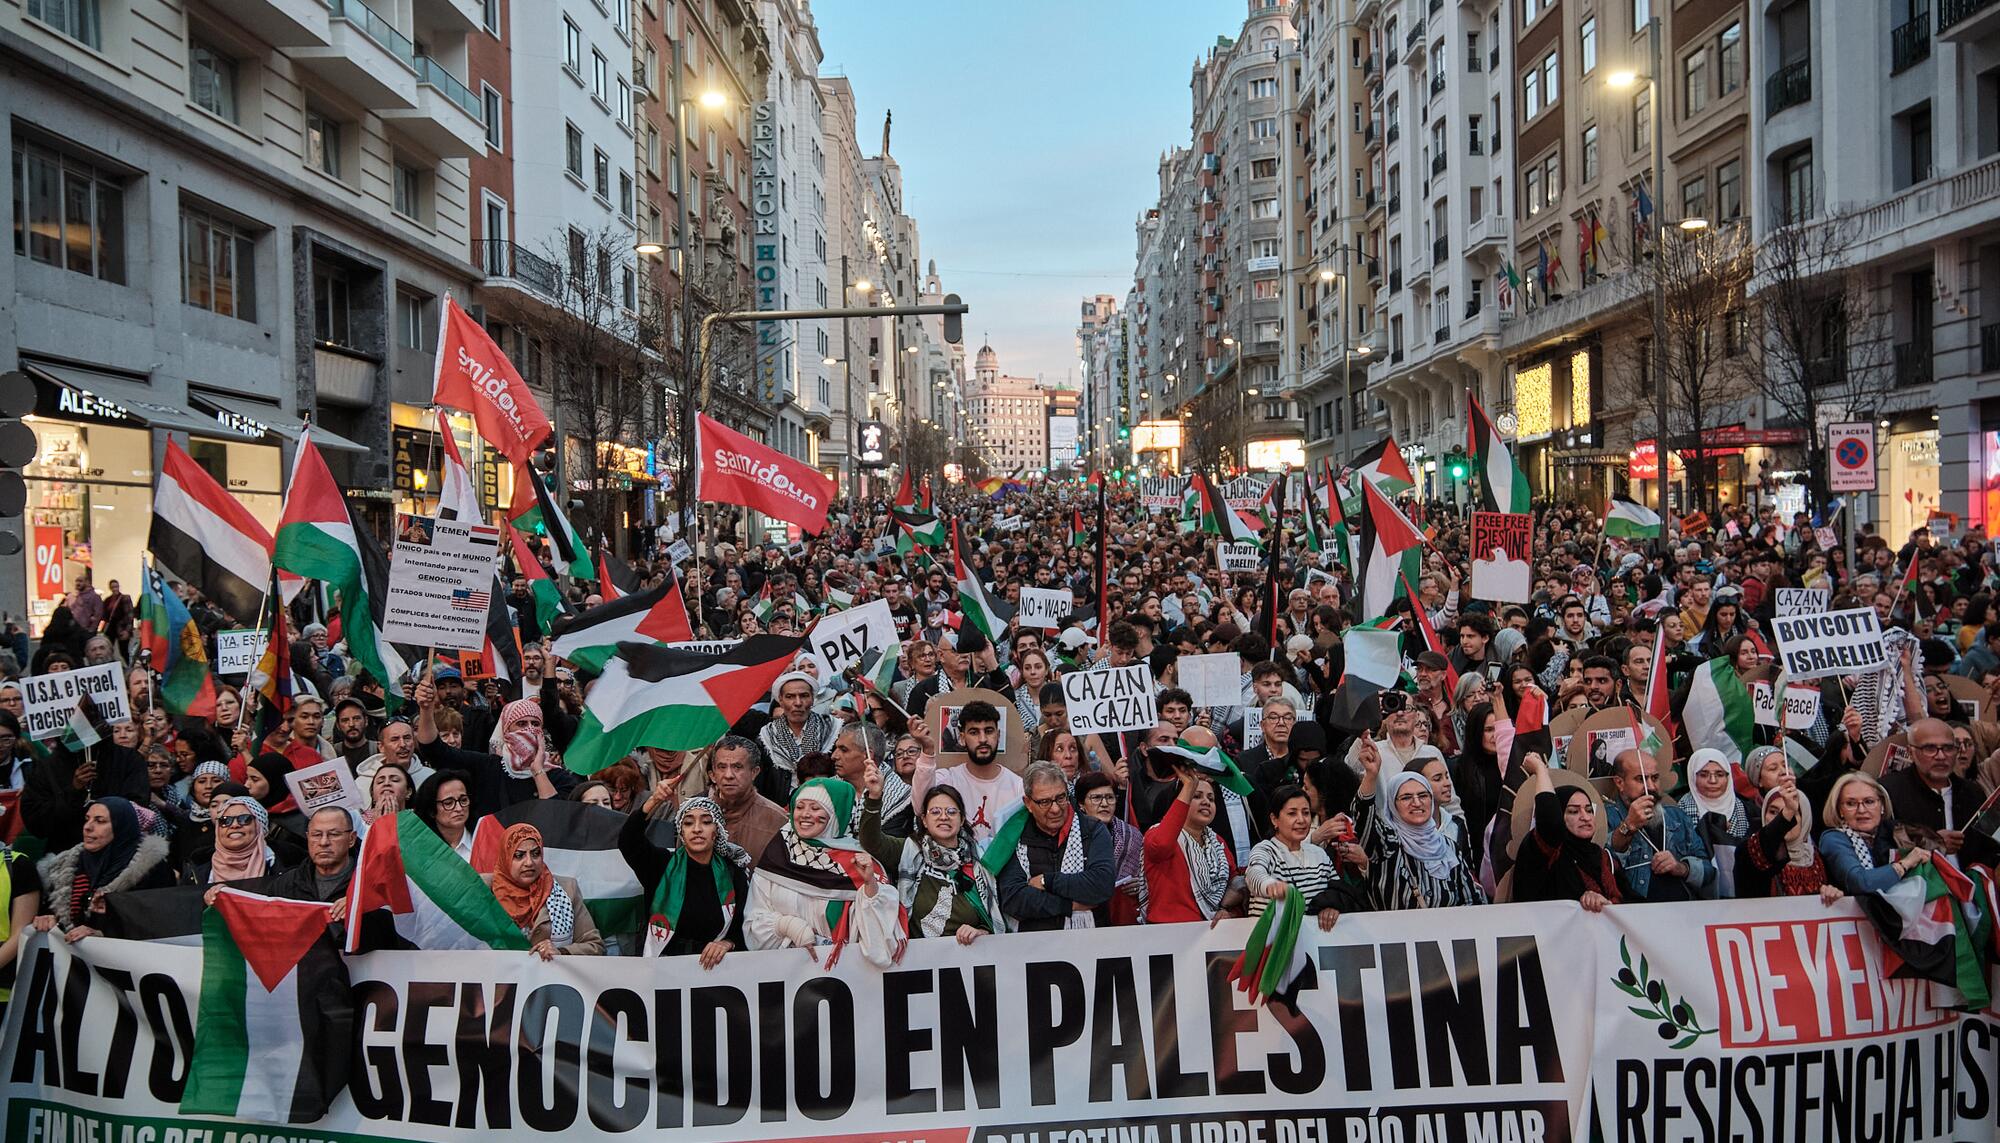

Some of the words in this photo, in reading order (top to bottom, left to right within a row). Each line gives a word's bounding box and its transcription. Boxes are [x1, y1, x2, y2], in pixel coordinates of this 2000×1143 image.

[753, 104, 775, 235] SENATOR
[1845, 428, 1870, 436] ACERA
[483, 450, 496, 506] TACOS
[714, 448, 818, 511] samidoun
[435, 525, 469, 537] YEMEN
[1475, 515, 1502, 528] FREE
[1503, 516, 1530, 530] FREE
[396, 543, 422, 553] ÚNICO
[453, 551, 461, 559] el
[462, 553, 492, 563] MUNDO
[1223, 545, 1257, 555] BOYCOTT
[404, 558, 446, 570] intentando
[447, 566, 468, 575] parar
[417, 573, 463, 585] GENOCIDIO
[391, 587, 423, 598] ESTADOS
[424, 591, 452, 601] UNIDOS
[1020, 597, 1036, 615] NO
[1044, 597, 1072, 618] WAR!
[1776, 590, 1823, 607] CAZAN
[413, 620, 450, 632] bombardea
[456, 627, 480, 636] YEMEN
[442, 614, 480, 624] GENOCIDIO
[1779, 611, 1874, 643] BOYCOTT
[821, 622, 869, 673] PAZ
[1786, 640, 1886, 675] ISRAEL!!!
[26, 679, 64, 705] U.S.A.
[64, 679, 74, 697] e
[74, 670, 118, 696] Israel,
[1066, 666, 1147, 703] CAZAN
[1072, 713, 1093, 730] en
[1092, 698, 1154, 729] GAZA!
[1715, 924, 1798, 1045] DE
[1790, 918, 1957, 1040] YEM
[9, 947, 196, 1104] ALTO
[348, 976, 857, 1133] GENOCIDIO
[882, 964, 1001, 1115] EN
[1025, 934, 1566, 1108] PALESTINA
[1615, 1036, 1923, 1143] RESISTENCIA
[1463, 1109, 1546, 1143] MAR
